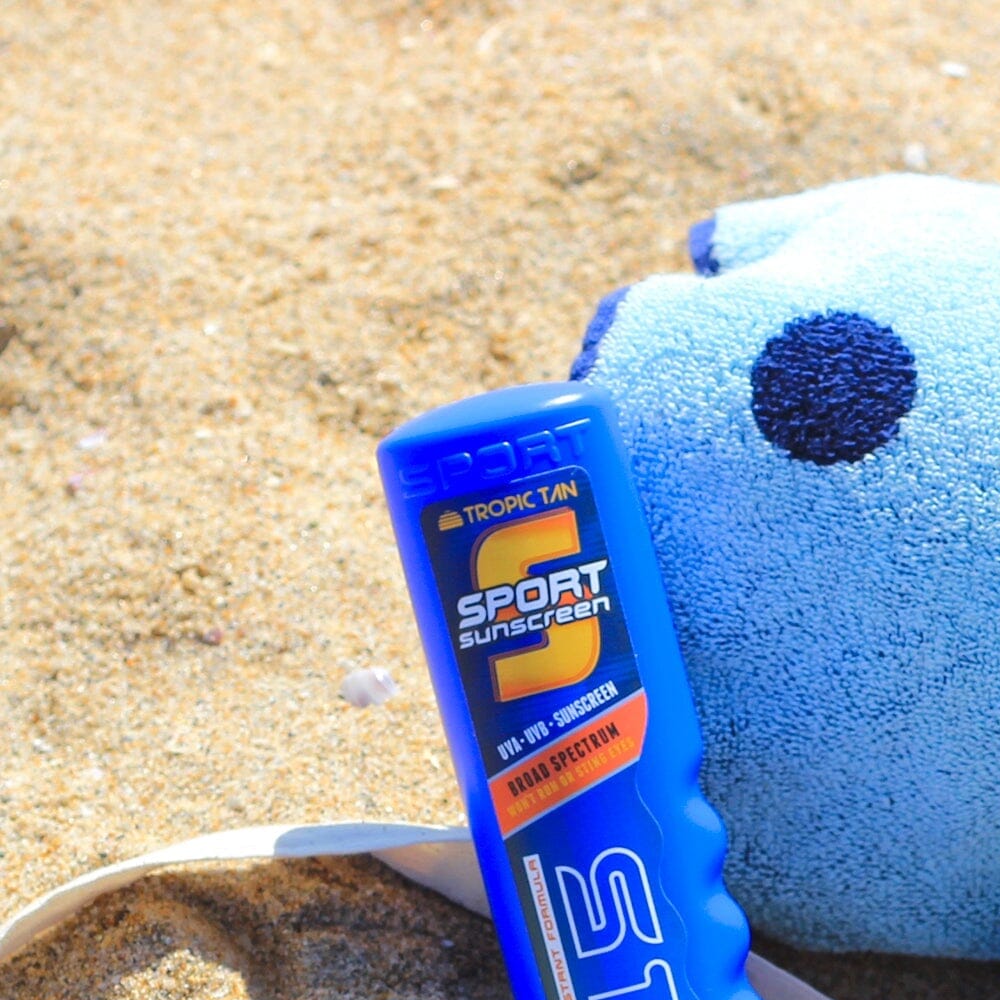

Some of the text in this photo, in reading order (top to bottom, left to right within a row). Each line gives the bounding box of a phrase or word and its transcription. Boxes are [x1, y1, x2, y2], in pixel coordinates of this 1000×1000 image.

[463, 479, 578, 524] TROPIC TAN
[457, 559, 608, 629] SPORT
[459, 596, 610, 649] sunscreen
[497, 680, 618, 760] UVA UVB SUNSCREEN
[507, 722, 620, 797] BROAD SPECTRUM
[528, 859, 555, 942] FORMULA
